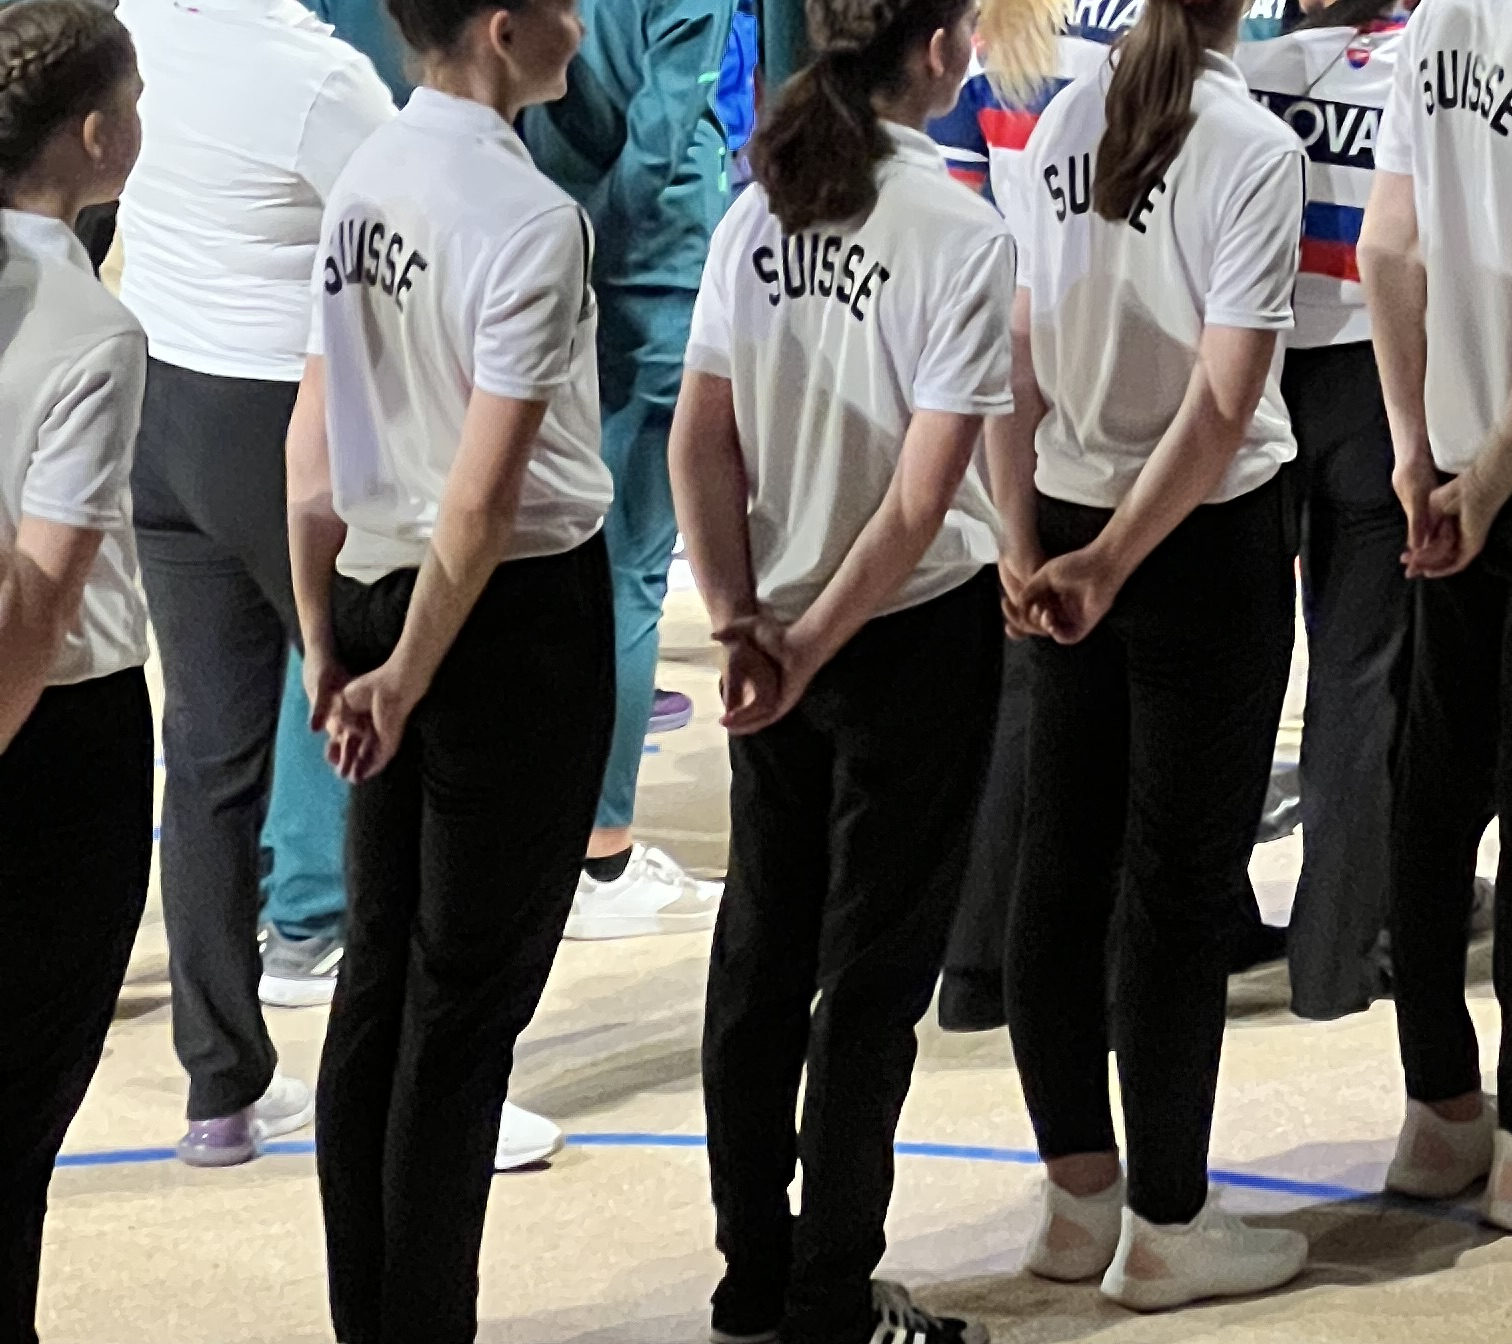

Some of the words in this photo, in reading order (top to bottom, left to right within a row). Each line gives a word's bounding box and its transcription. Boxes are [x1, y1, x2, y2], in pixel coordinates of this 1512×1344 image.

[1044, 153, 1166, 234] SUE
[325, 219, 428, 313] SUISSE
[752, 233, 889, 321] SUISSE
